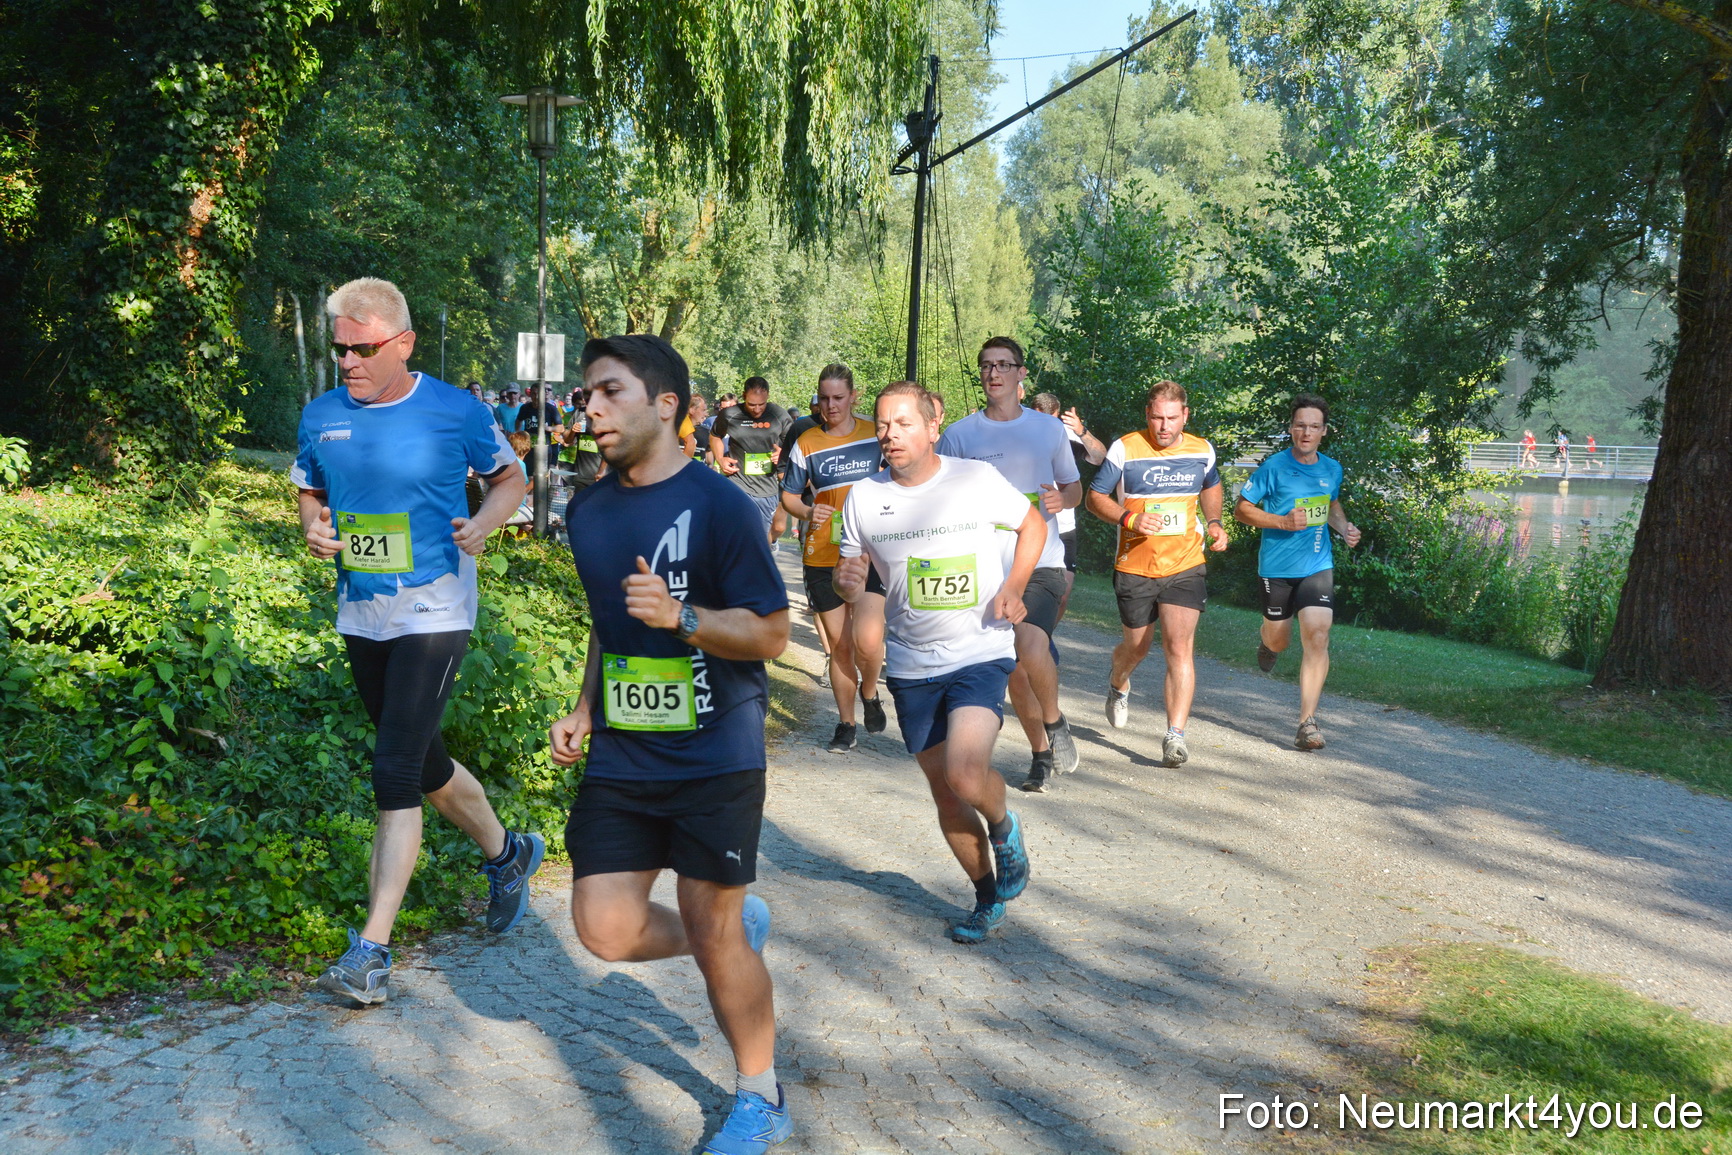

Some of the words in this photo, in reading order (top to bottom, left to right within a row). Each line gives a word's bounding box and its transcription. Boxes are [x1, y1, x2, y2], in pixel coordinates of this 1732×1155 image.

[828, 457, 872, 473] Fischer
[833, 468, 870, 477] AUTOMOBILE
[1153, 471, 1196, 483] Fischer
[871, 529, 925, 543] RUPPRECHT
[931, 522, 978, 536] HOLZBAU
[350, 534, 388, 557] 821
[917, 574, 970, 595] 1752
[613, 681, 681, 710] 1605
